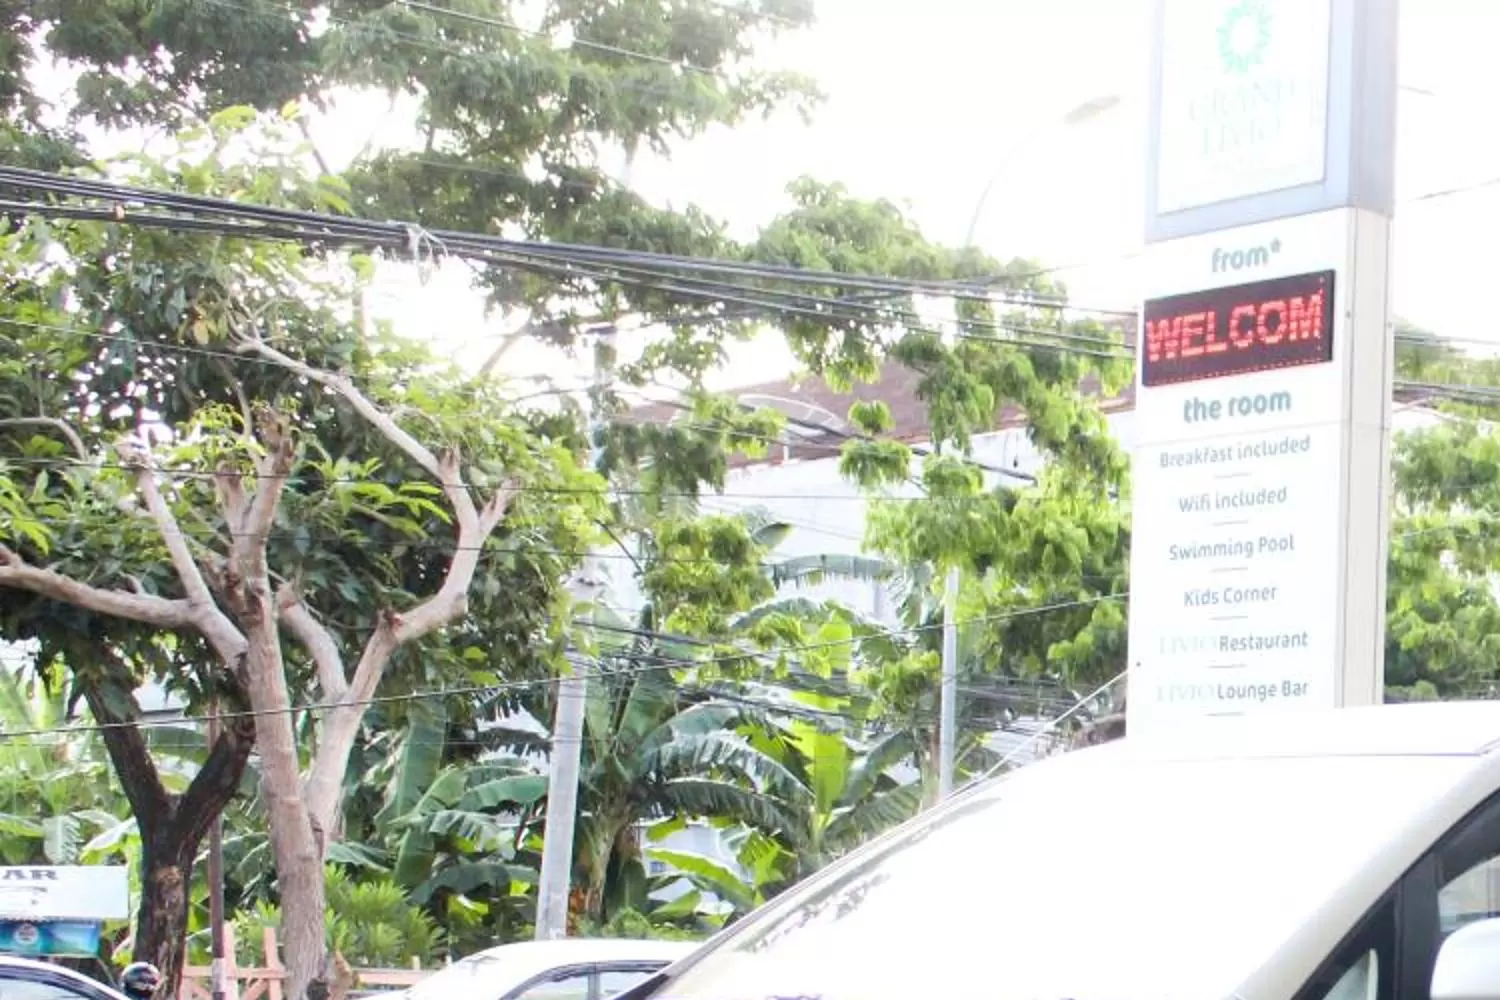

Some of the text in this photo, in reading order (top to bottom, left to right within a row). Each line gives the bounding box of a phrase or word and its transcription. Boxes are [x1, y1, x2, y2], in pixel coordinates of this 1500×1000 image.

[1145, 294, 1325, 362] WELCOM
[1183, 390, 1292, 423] the room
[1159, 435, 1311, 468] Breakfast included
[1178, 486, 1288, 513] Wifi included
[1169, 534, 1295, 561] Swimming Pool
[1184, 585, 1278, 608] Kids Corner
[1219, 630, 1309, 652] Restaurant
[1217, 682, 1278, 703] Lounge
[1281, 679, 1310, 698] Bar
